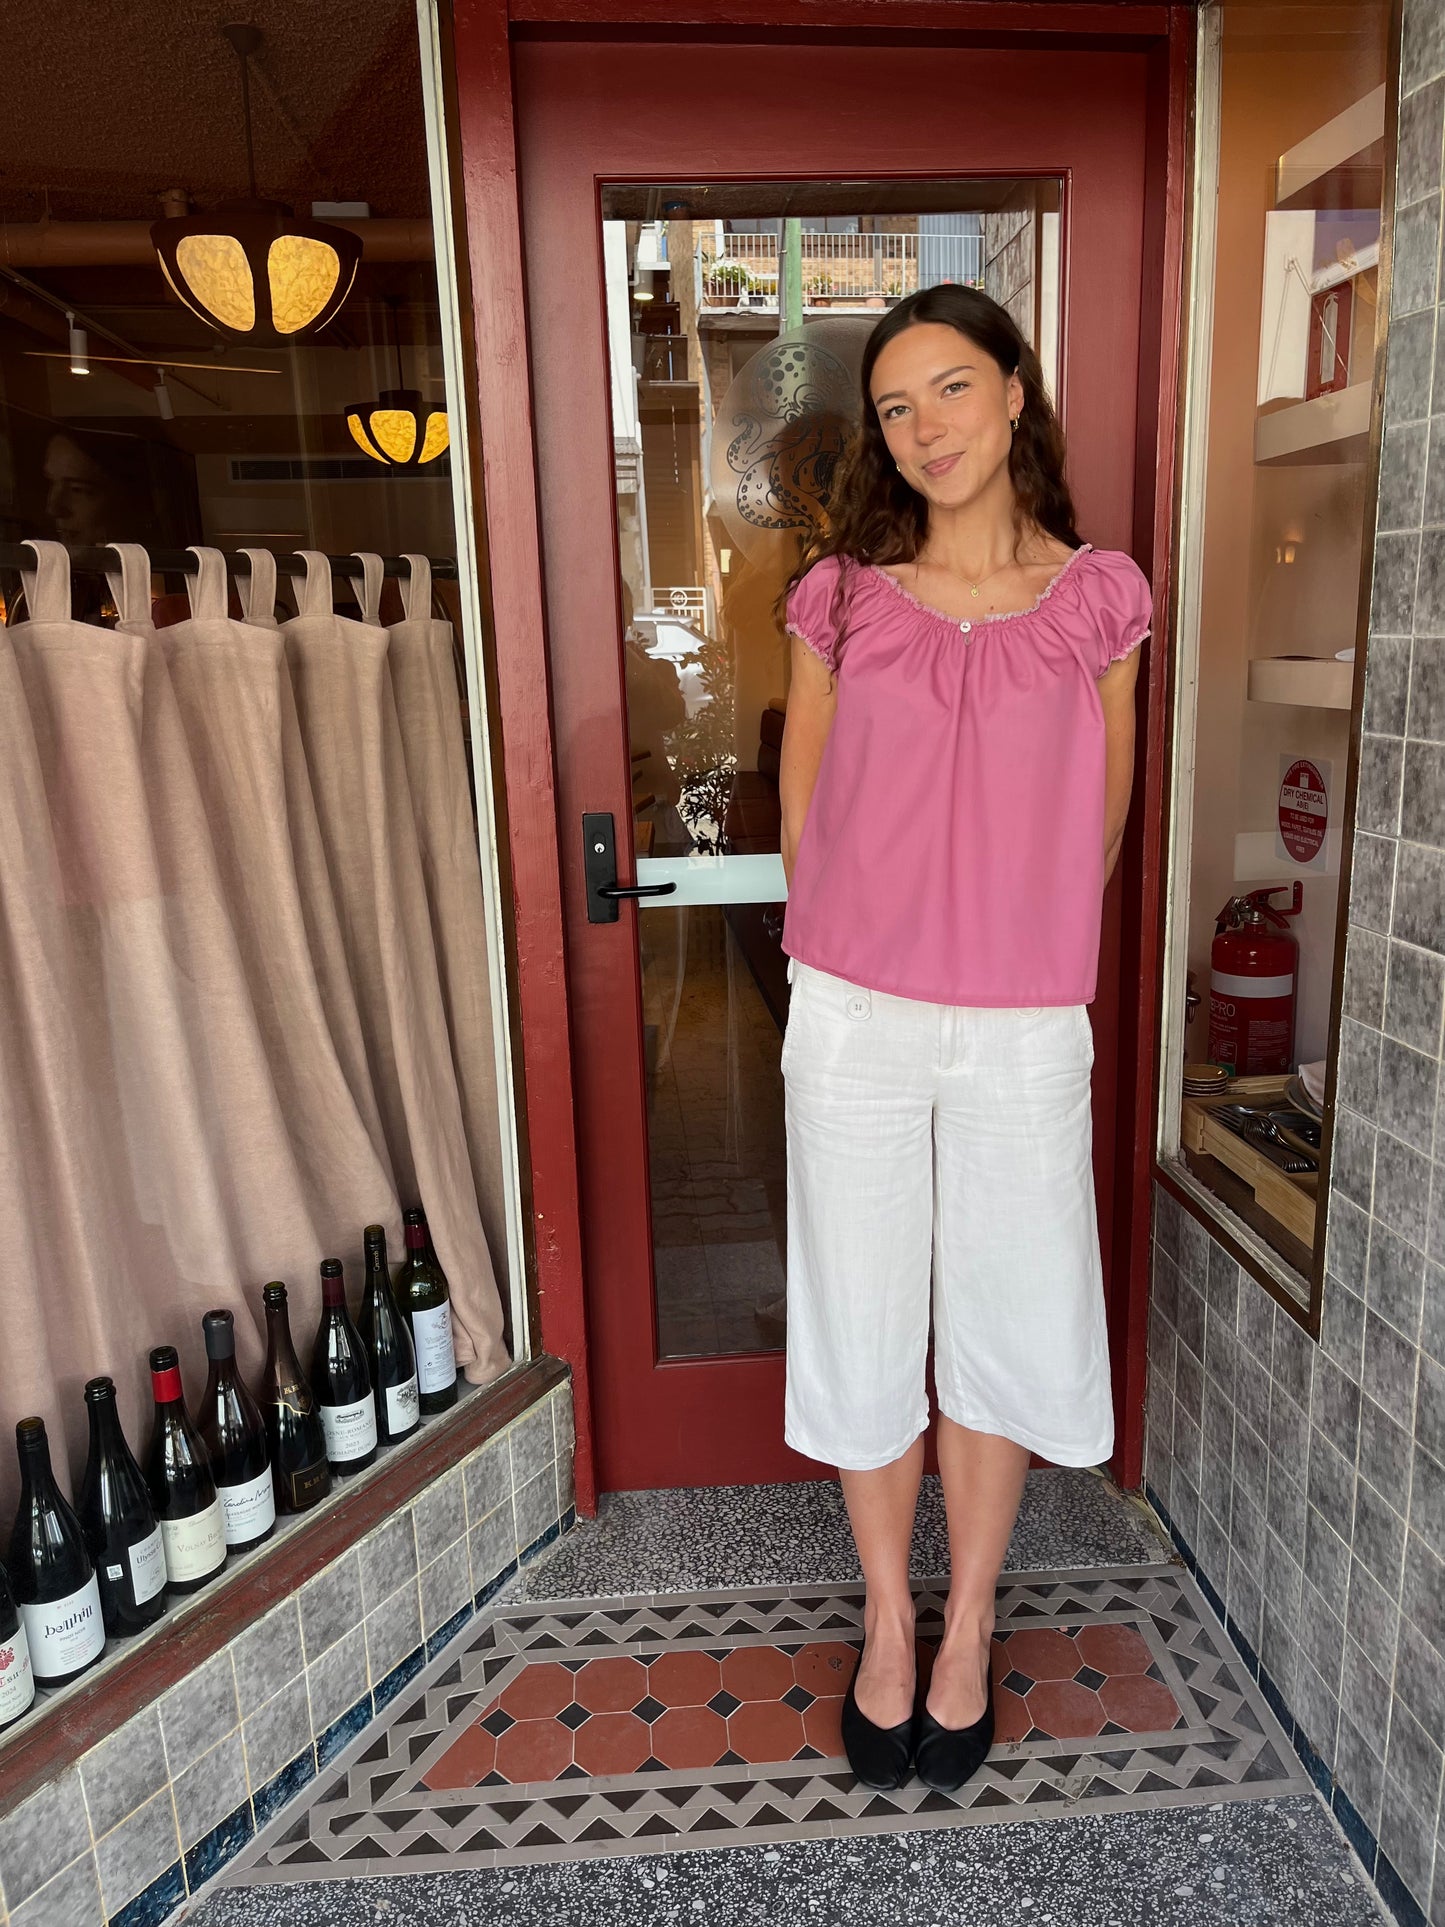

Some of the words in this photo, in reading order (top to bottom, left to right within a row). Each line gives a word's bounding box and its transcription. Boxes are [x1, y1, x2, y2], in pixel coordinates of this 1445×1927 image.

[1283, 787, 1294, 799] DRY
[1295, 790, 1324, 805] CHEMICAL
[283, 1383, 299, 1395] KR
[177, 1539, 206, 1553] VOLNAY
[45, 1605, 93, 1638] bellhill
